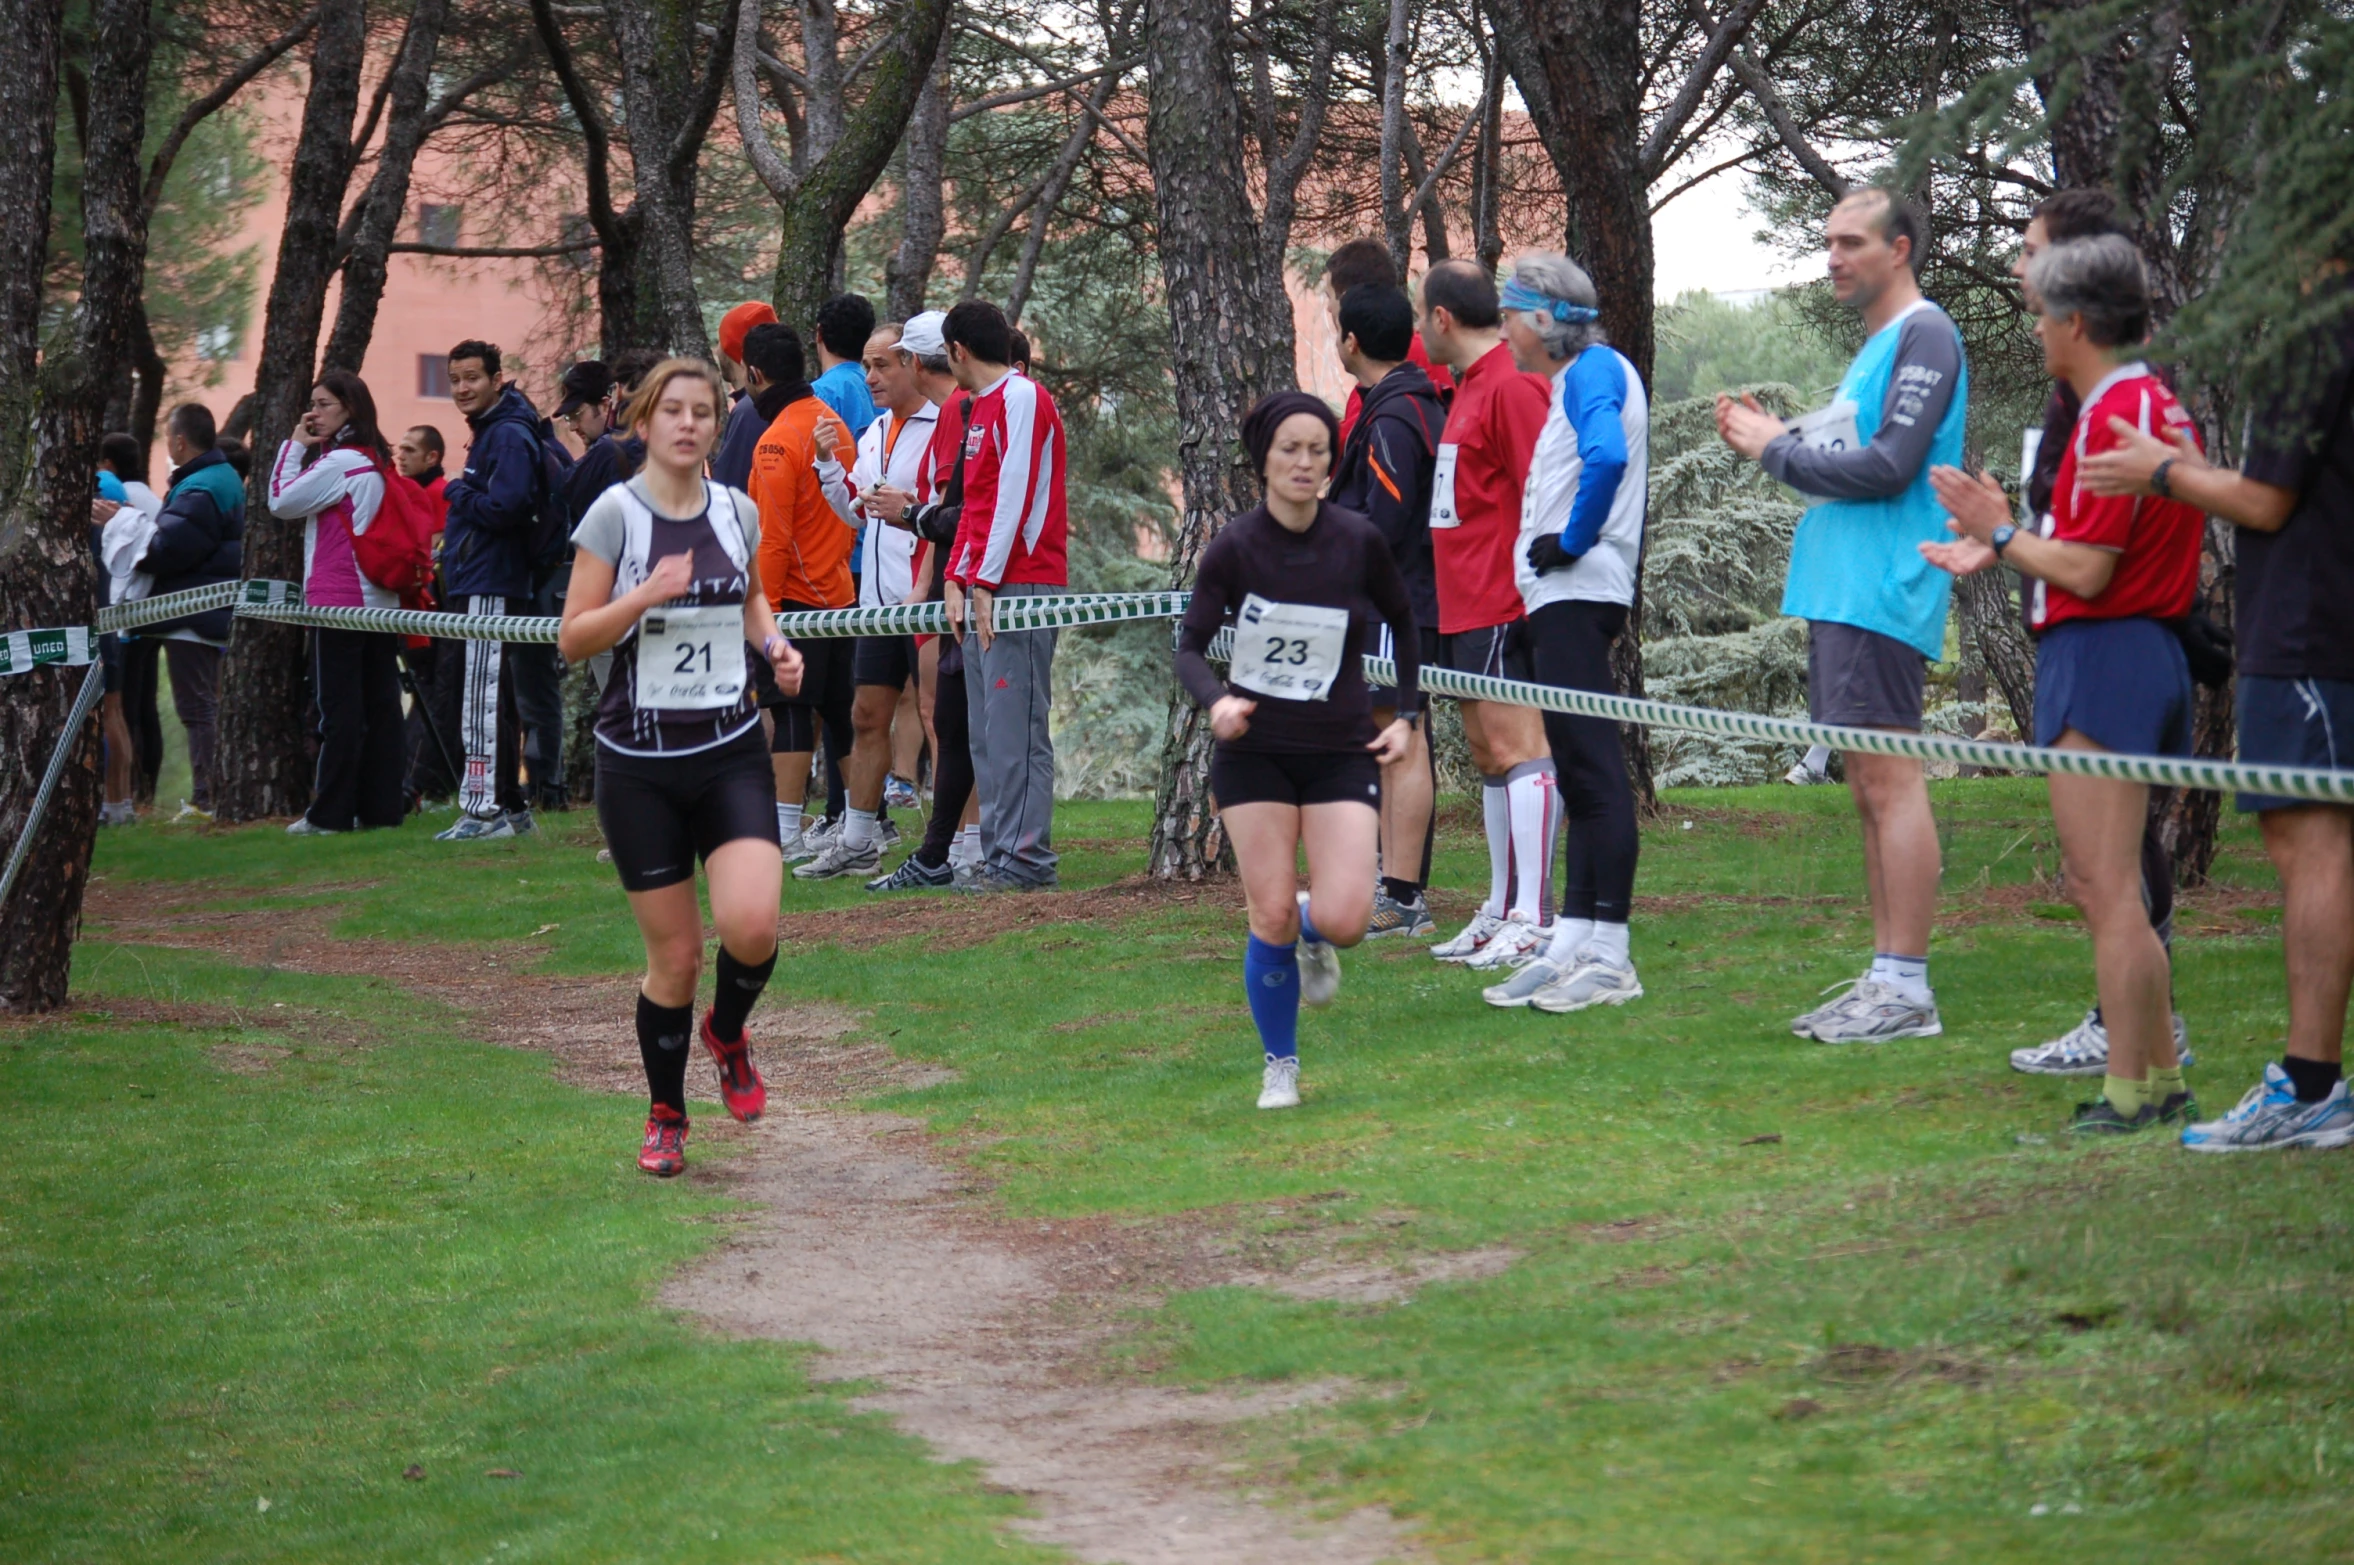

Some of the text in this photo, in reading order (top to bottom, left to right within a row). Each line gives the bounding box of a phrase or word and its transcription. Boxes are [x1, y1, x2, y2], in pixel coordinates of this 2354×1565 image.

[33, 641, 65, 655] UNED
[673, 640, 713, 673] 21
[1264, 636, 1309, 666] 23
